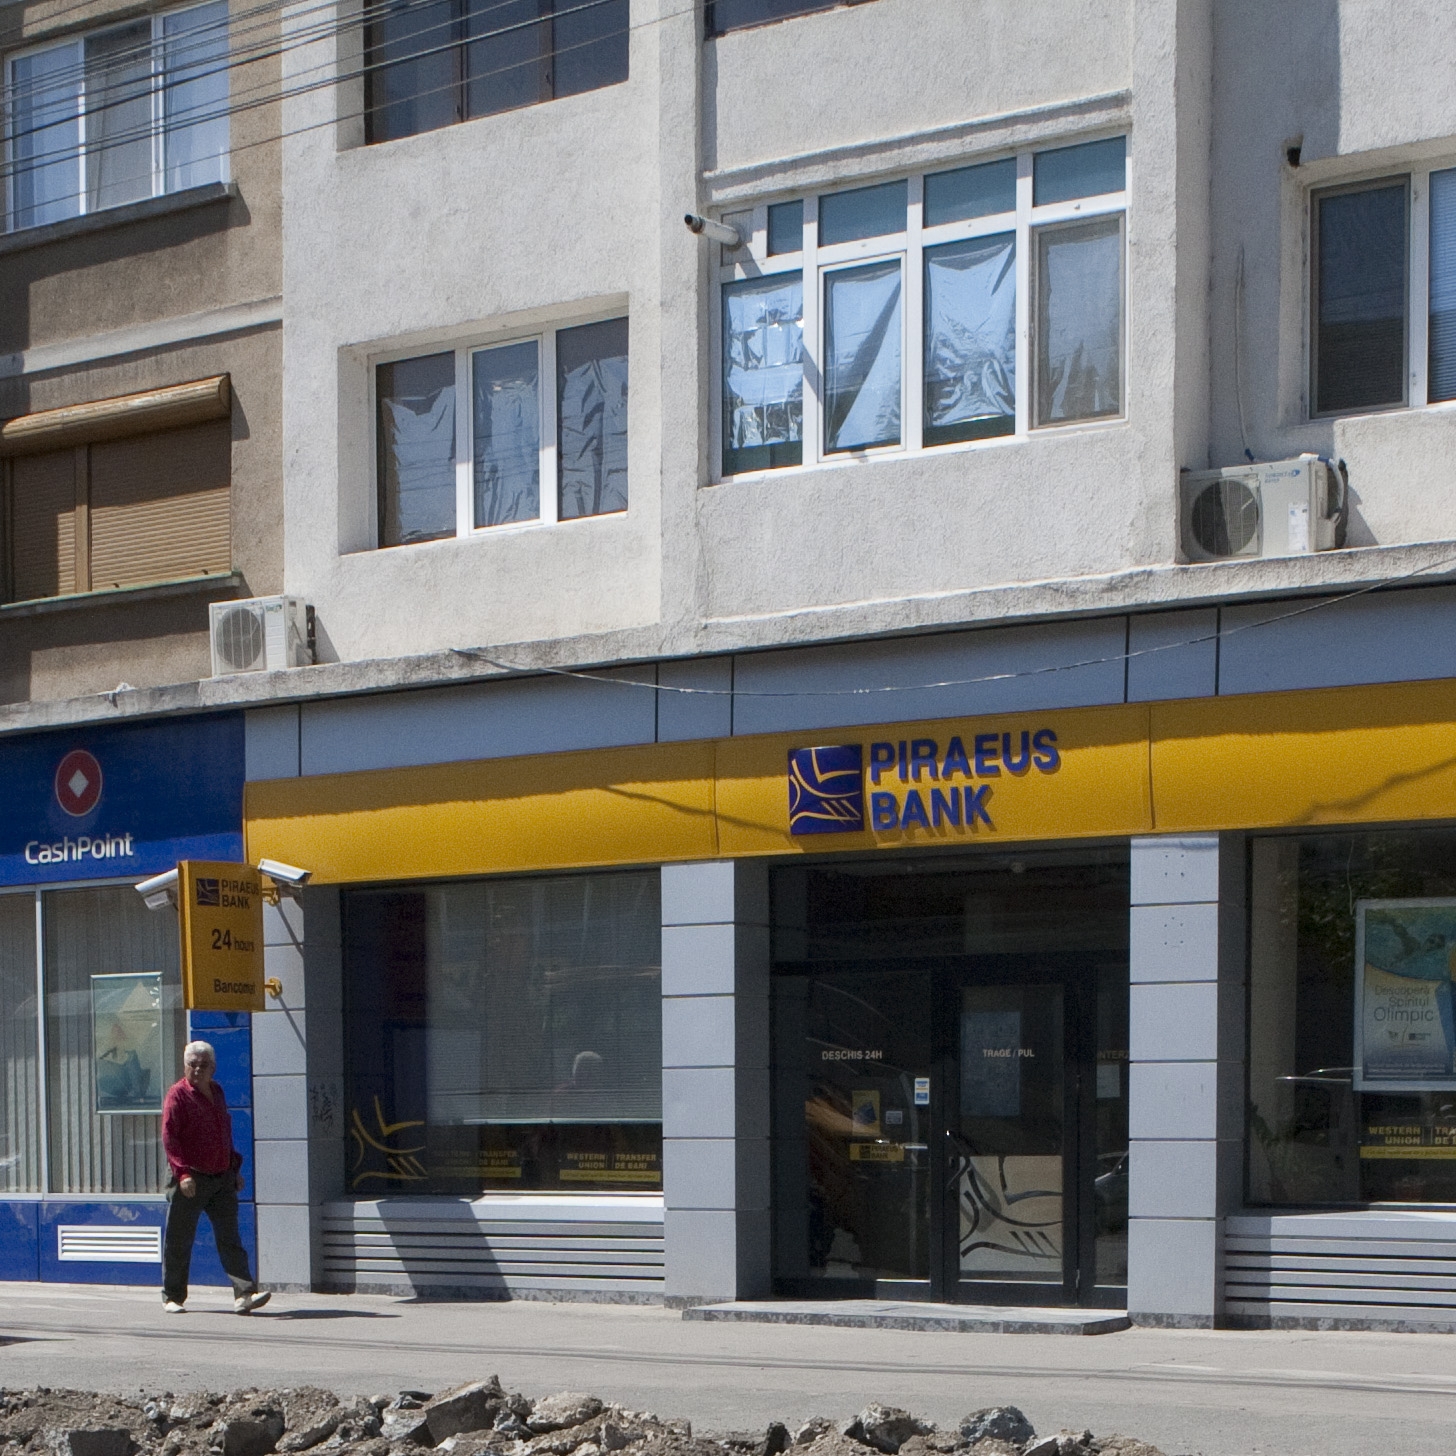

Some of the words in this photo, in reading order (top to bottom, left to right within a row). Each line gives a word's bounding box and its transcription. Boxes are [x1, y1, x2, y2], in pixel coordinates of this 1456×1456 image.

[870, 729, 1059, 782] PIRAEUS
[870, 784, 992, 831] BANK
[25, 832, 134, 865] CashPoint
[221, 879, 260, 896] PIRAEUS
[222, 894, 250, 909] BANK
[211, 928, 232, 951] 24
[234, 937, 255, 952] hours
[213, 978, 256, 995] Bancomat
[1373, 1006, 1435, 1024] Olimpic
[822, 1051, 863, 1060] DESCHIS
[865, 1050, 882, 1060] 24H
[983, 1049, 1011, 1057] TRAGE
[1018, 1049, 1035, 1057] PUL
[1369, 1126, 1421, 1135] WESTERN
[1385, 1136, 1421, 1144] UNION
[1435, 1136, 1448, 1144] DE
[615, 1153, 657, 1161] TRANSFER
